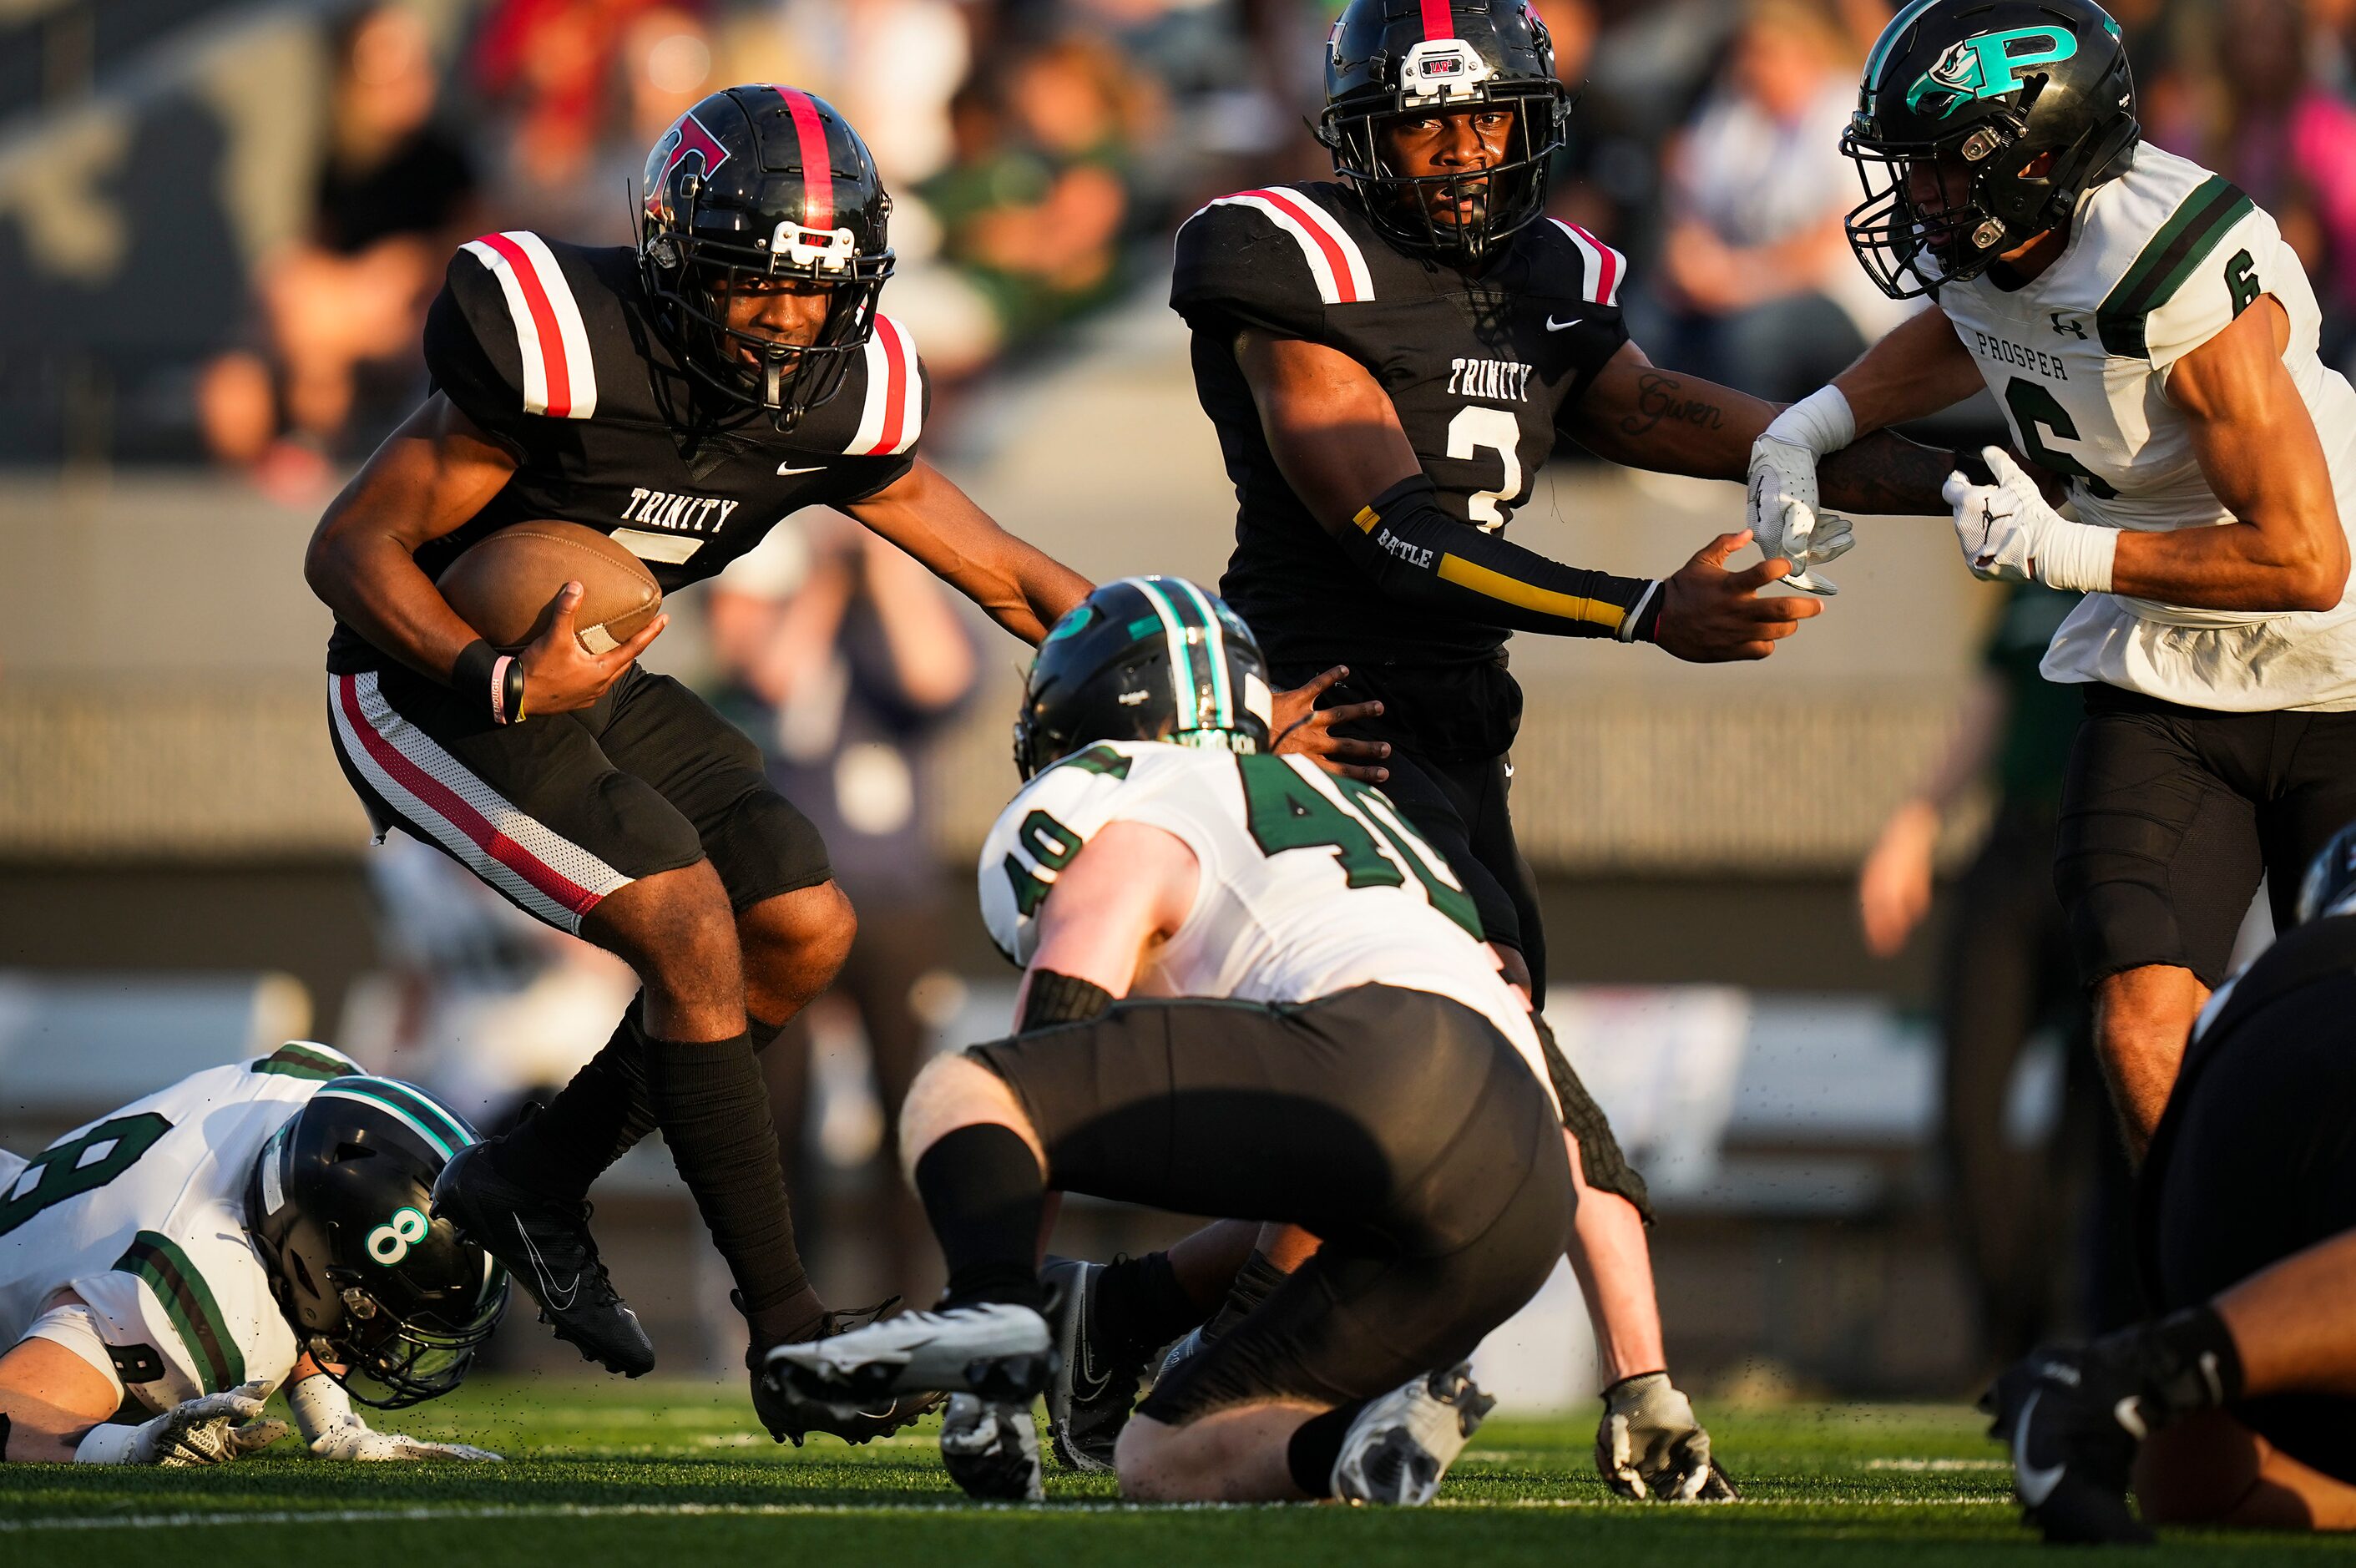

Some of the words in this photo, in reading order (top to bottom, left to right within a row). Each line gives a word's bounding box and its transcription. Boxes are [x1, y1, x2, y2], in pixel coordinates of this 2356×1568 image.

[1964, 25, 2078, 99] P
[2223, 247, 2262, 321] 6
[1447, 358, 1533, 403] TRINITY
[1975, 331, 2069, 381] PROSPER
[1619, 373, 1724, 435] Gwen
[2005, 376, 2125, 501] 6
[620, 487, 740, 534] TRINITY
[1377, 528, 1434, 569] BATTLE
[1236, 752, 1484, 943] 40
[365, 1206, 429, 1267] 8
[104, 1342, 166, 1383] 8
